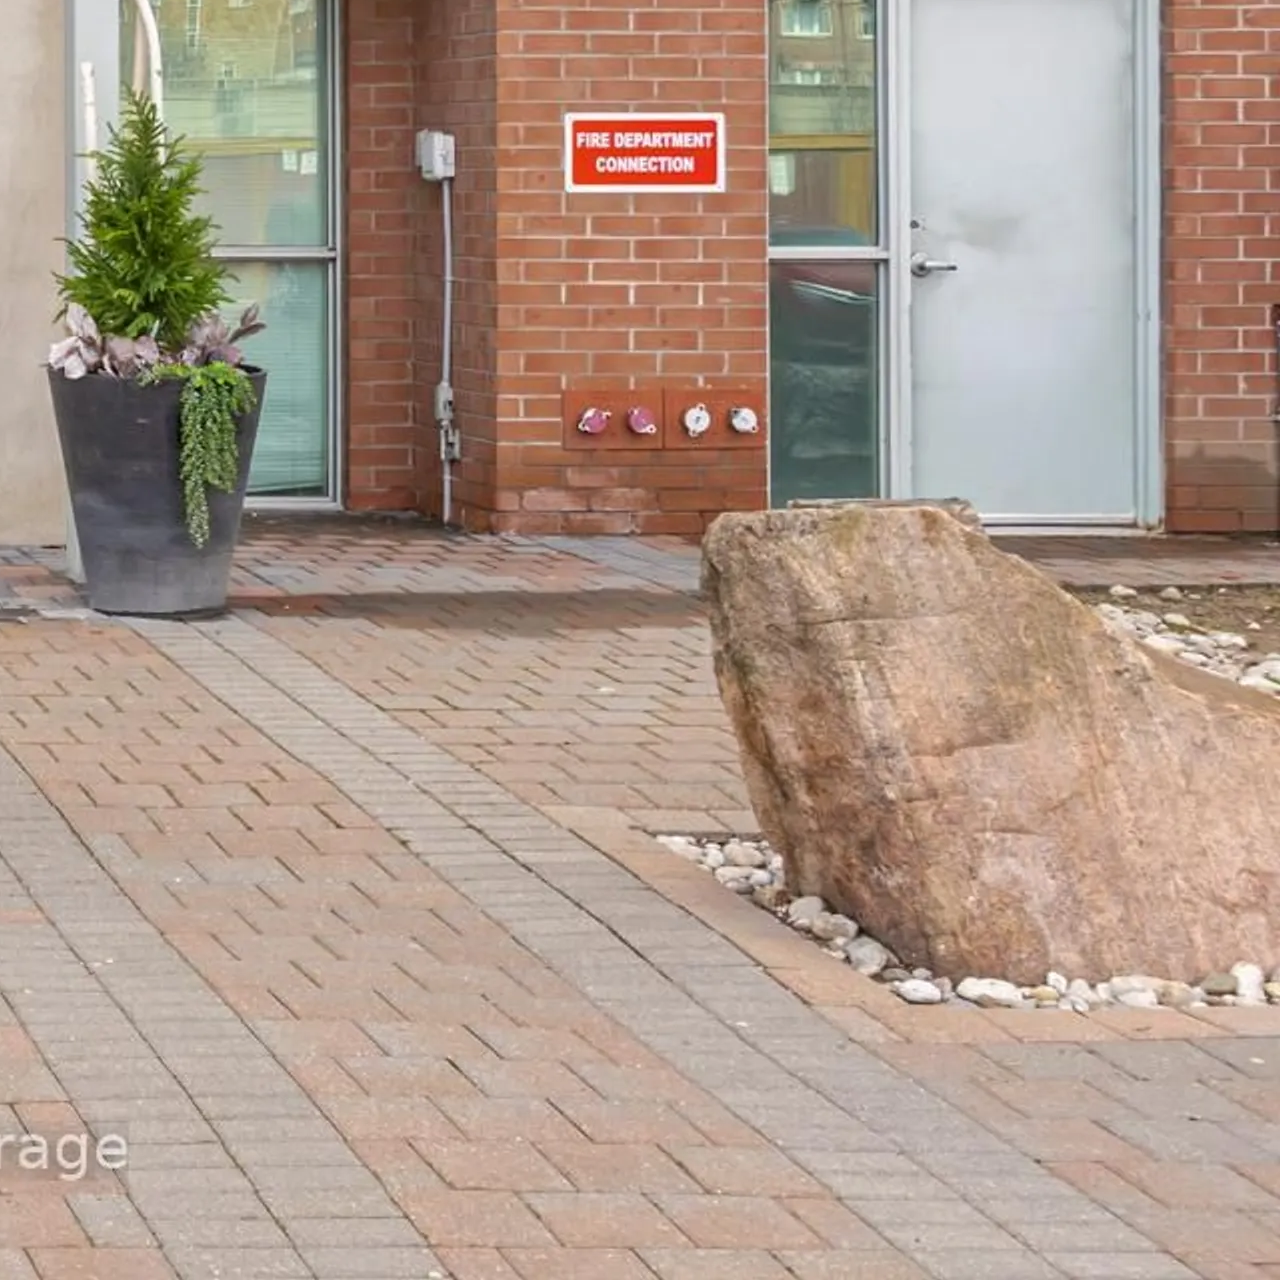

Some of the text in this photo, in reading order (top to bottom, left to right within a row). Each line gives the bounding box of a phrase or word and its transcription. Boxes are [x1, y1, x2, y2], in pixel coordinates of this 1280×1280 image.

[576, 131, 714, 149] FIRE DEPARTMENT
[595, 155, 695, 174] CONNECTION
